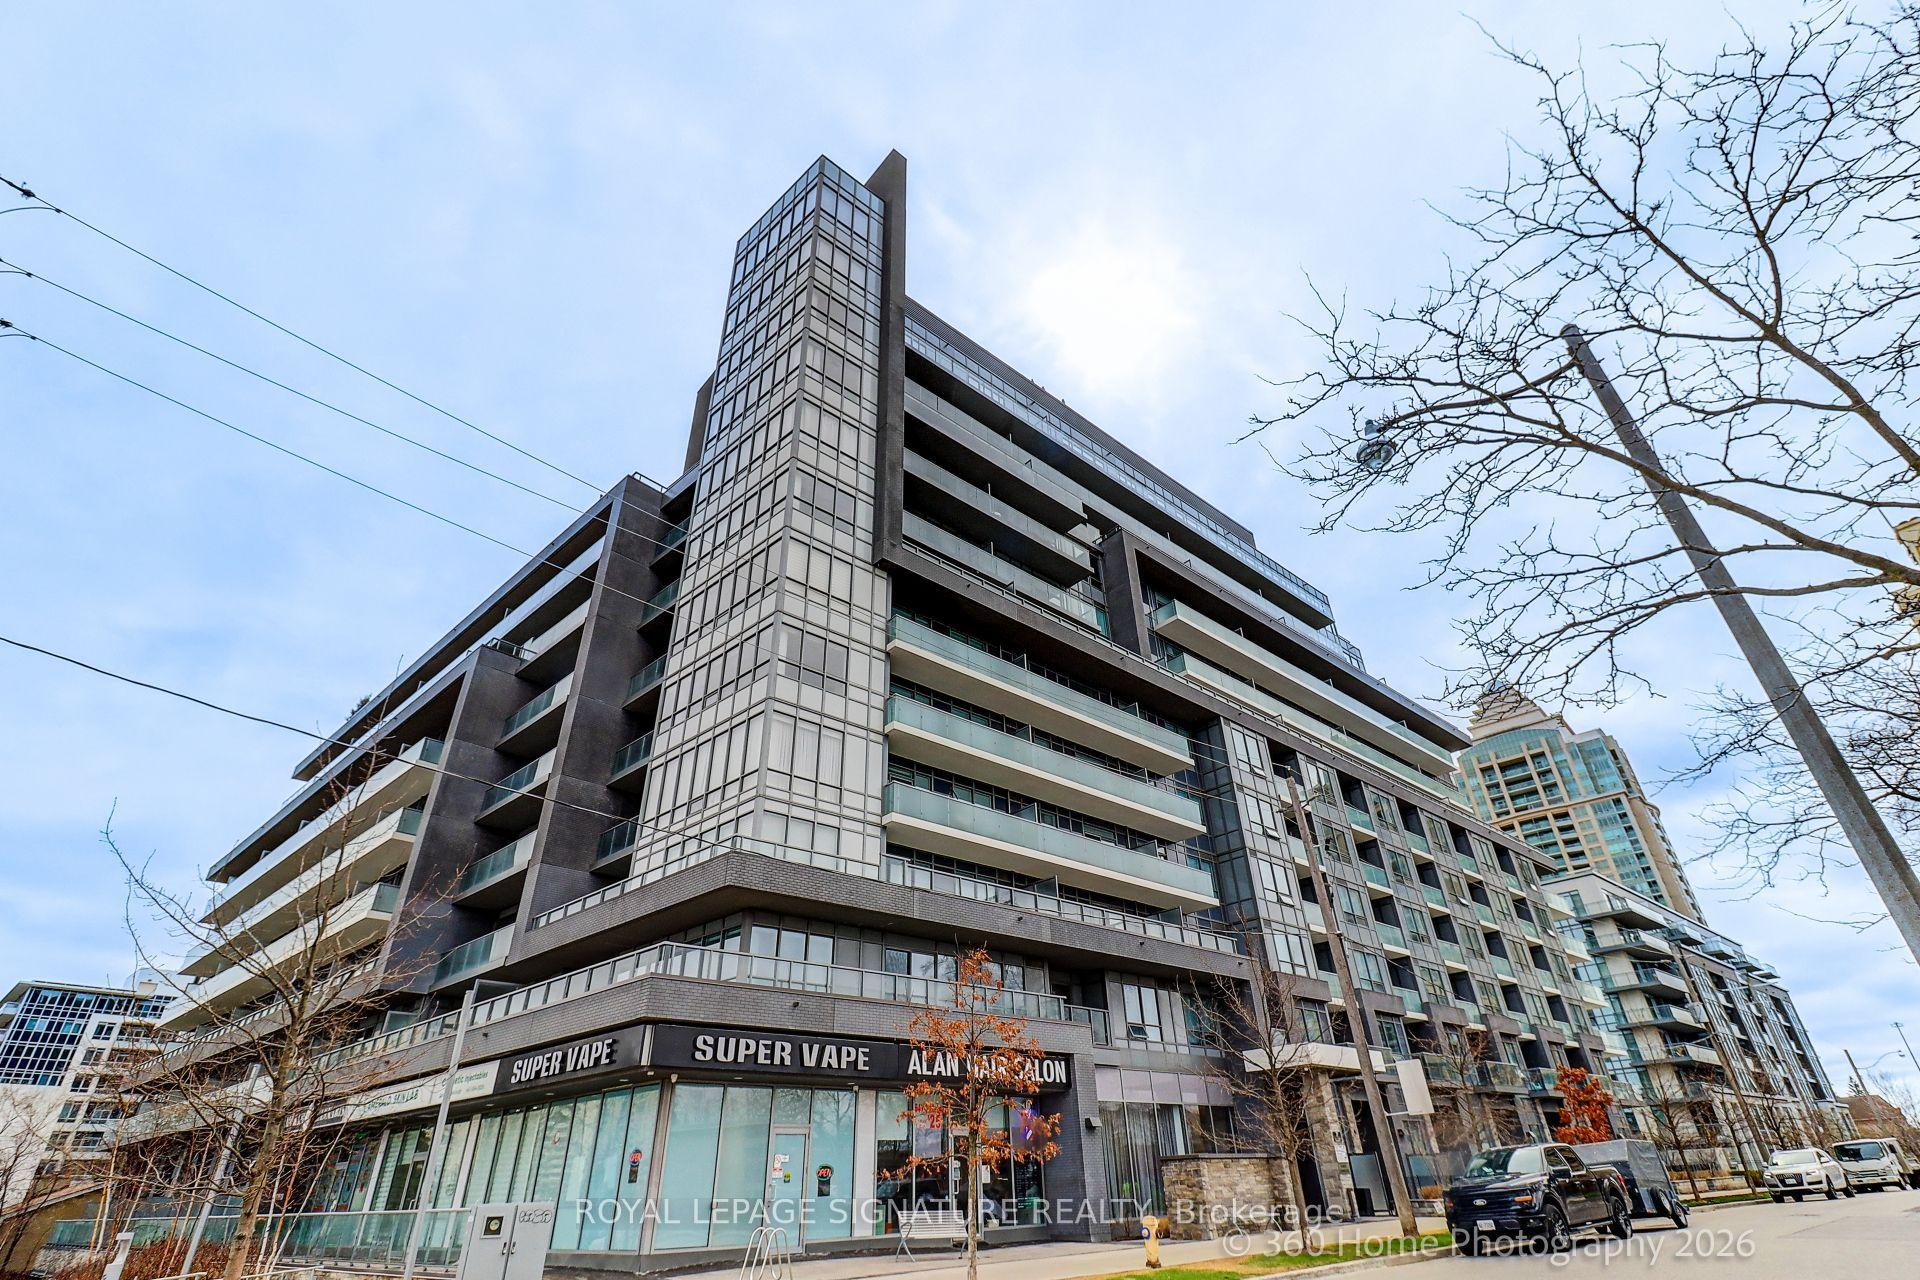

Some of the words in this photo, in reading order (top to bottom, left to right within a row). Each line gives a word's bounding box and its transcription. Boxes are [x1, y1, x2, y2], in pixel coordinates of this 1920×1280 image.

[510, 1050, 563, 1084] SUPER
[566, 1038, 613, 1072] VAPE
[694, 1034, 792, 1066] SUPER
[802, 1042, 870, 1071] VAPE
[907, 1049, 959, 1077] ALAN
